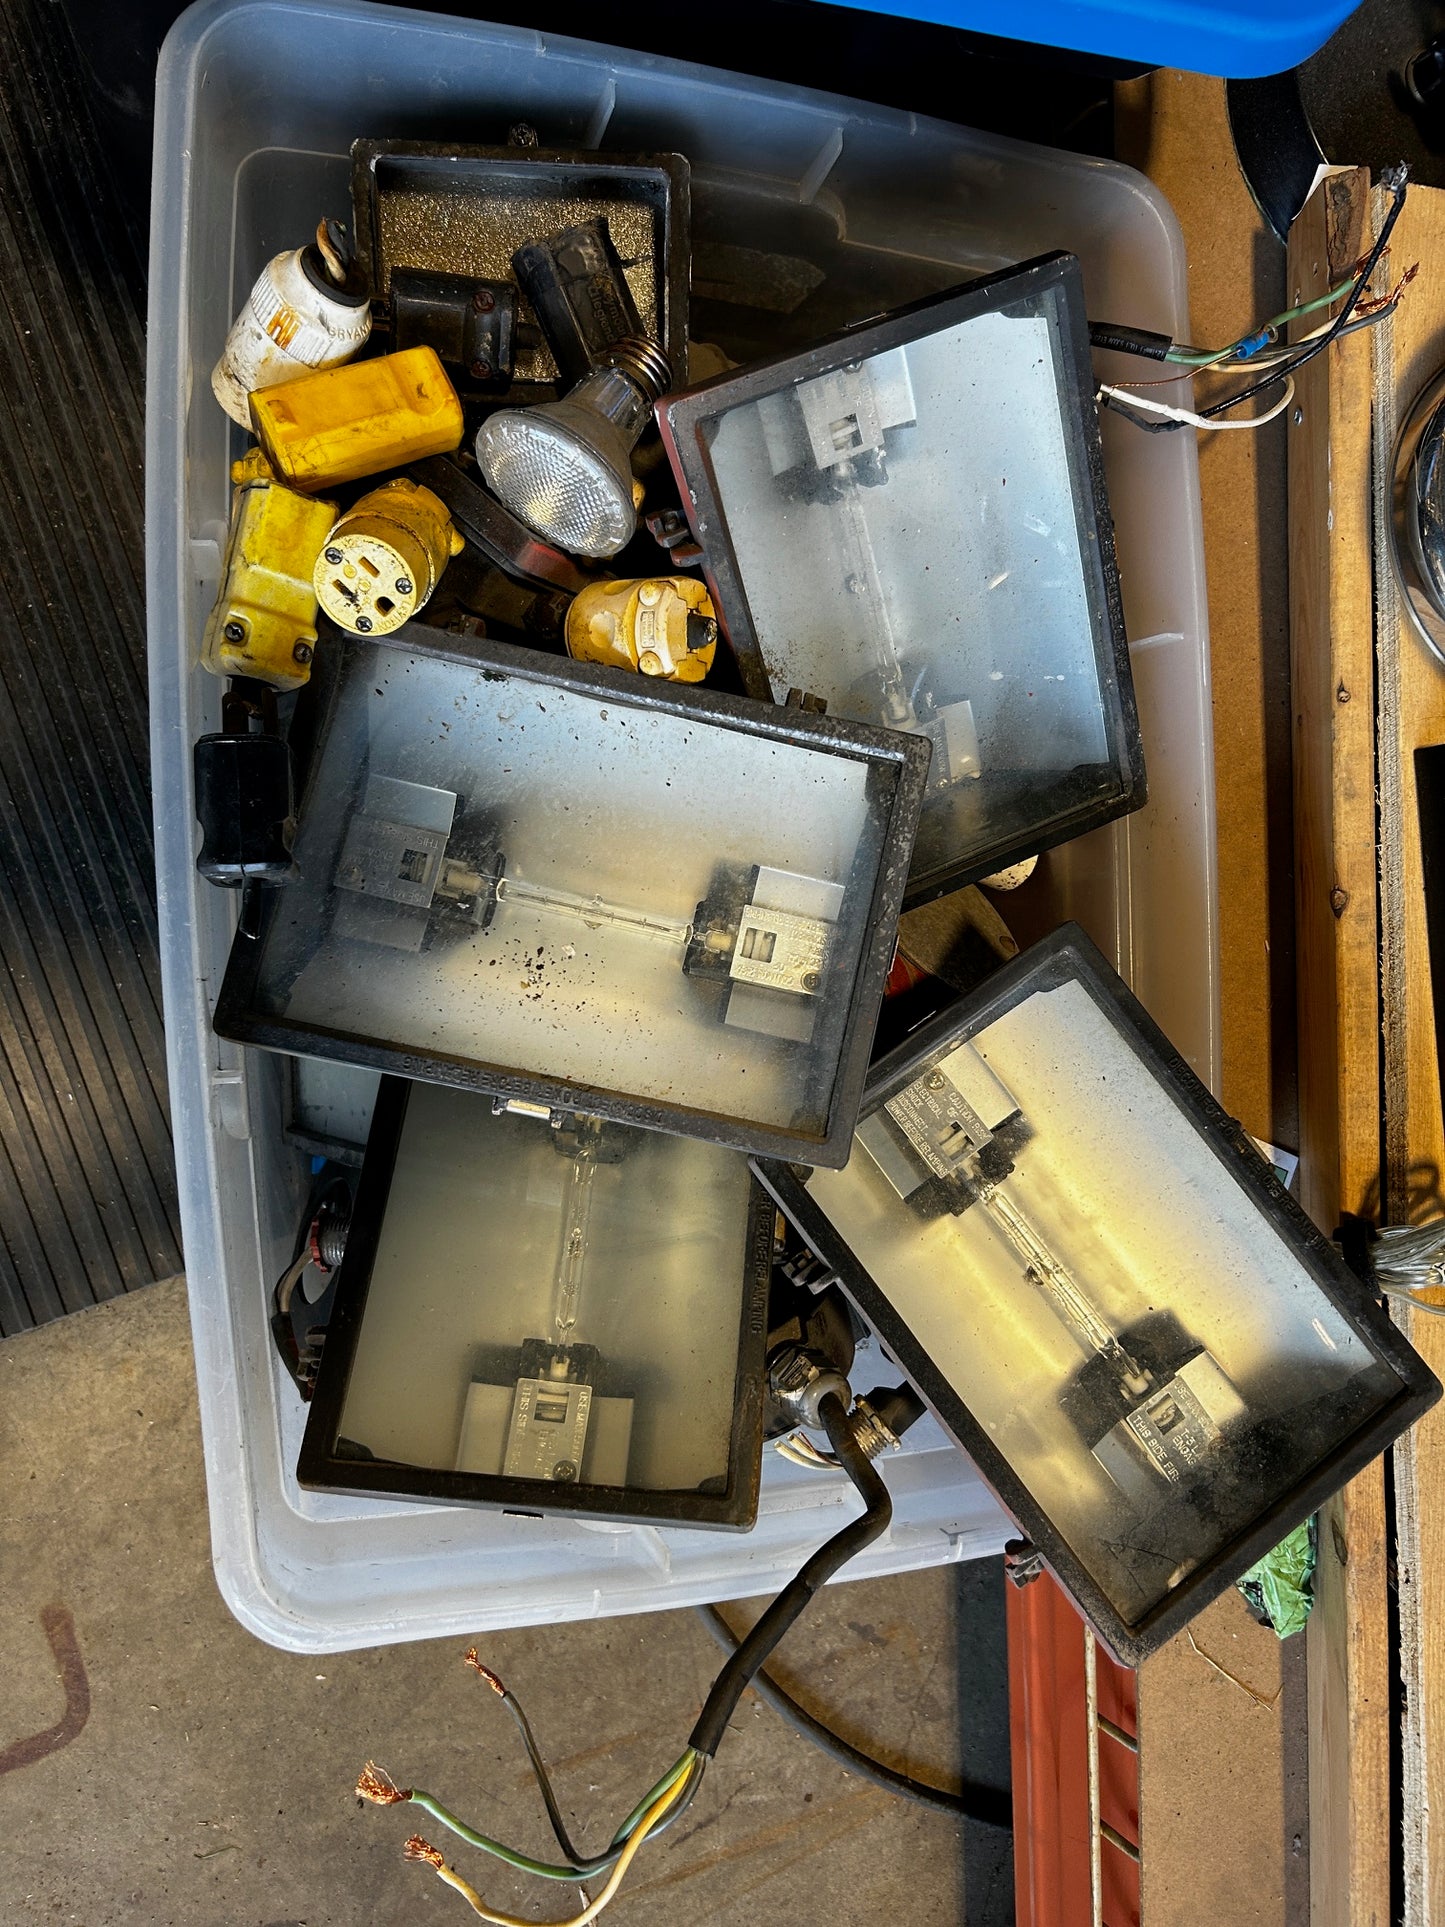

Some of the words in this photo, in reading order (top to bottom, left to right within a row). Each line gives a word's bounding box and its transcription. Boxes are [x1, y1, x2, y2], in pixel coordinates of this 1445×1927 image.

[375, 601, 410, 633] LEVITON
[905, 1088, 923, 1108] SHOCK
[914, 1082, 944, 1118] ELECTRICAL
[946, 1107, 957, 1118] OF
[888, 1100, 907, 1122] POWER
[903, 1120, 923, 1143] BEFORE
[919, 1142, 947, 1175] RELAMPING
[755, 1214, 769, 1258] BEFORE
[751, 1261, 766, 1333] RELAMPING
[518, 1385, 531, 1410] THIS
[1174, 1383, 1189, 1399] USE
[1132, 1415, 1151, 1438] THIS
[1148, 1438, 1167, 1461] SIDE
[1171, 1435, 1197, 1468] ENGAG
[1179, 1428, 1194, 1445] T-3
